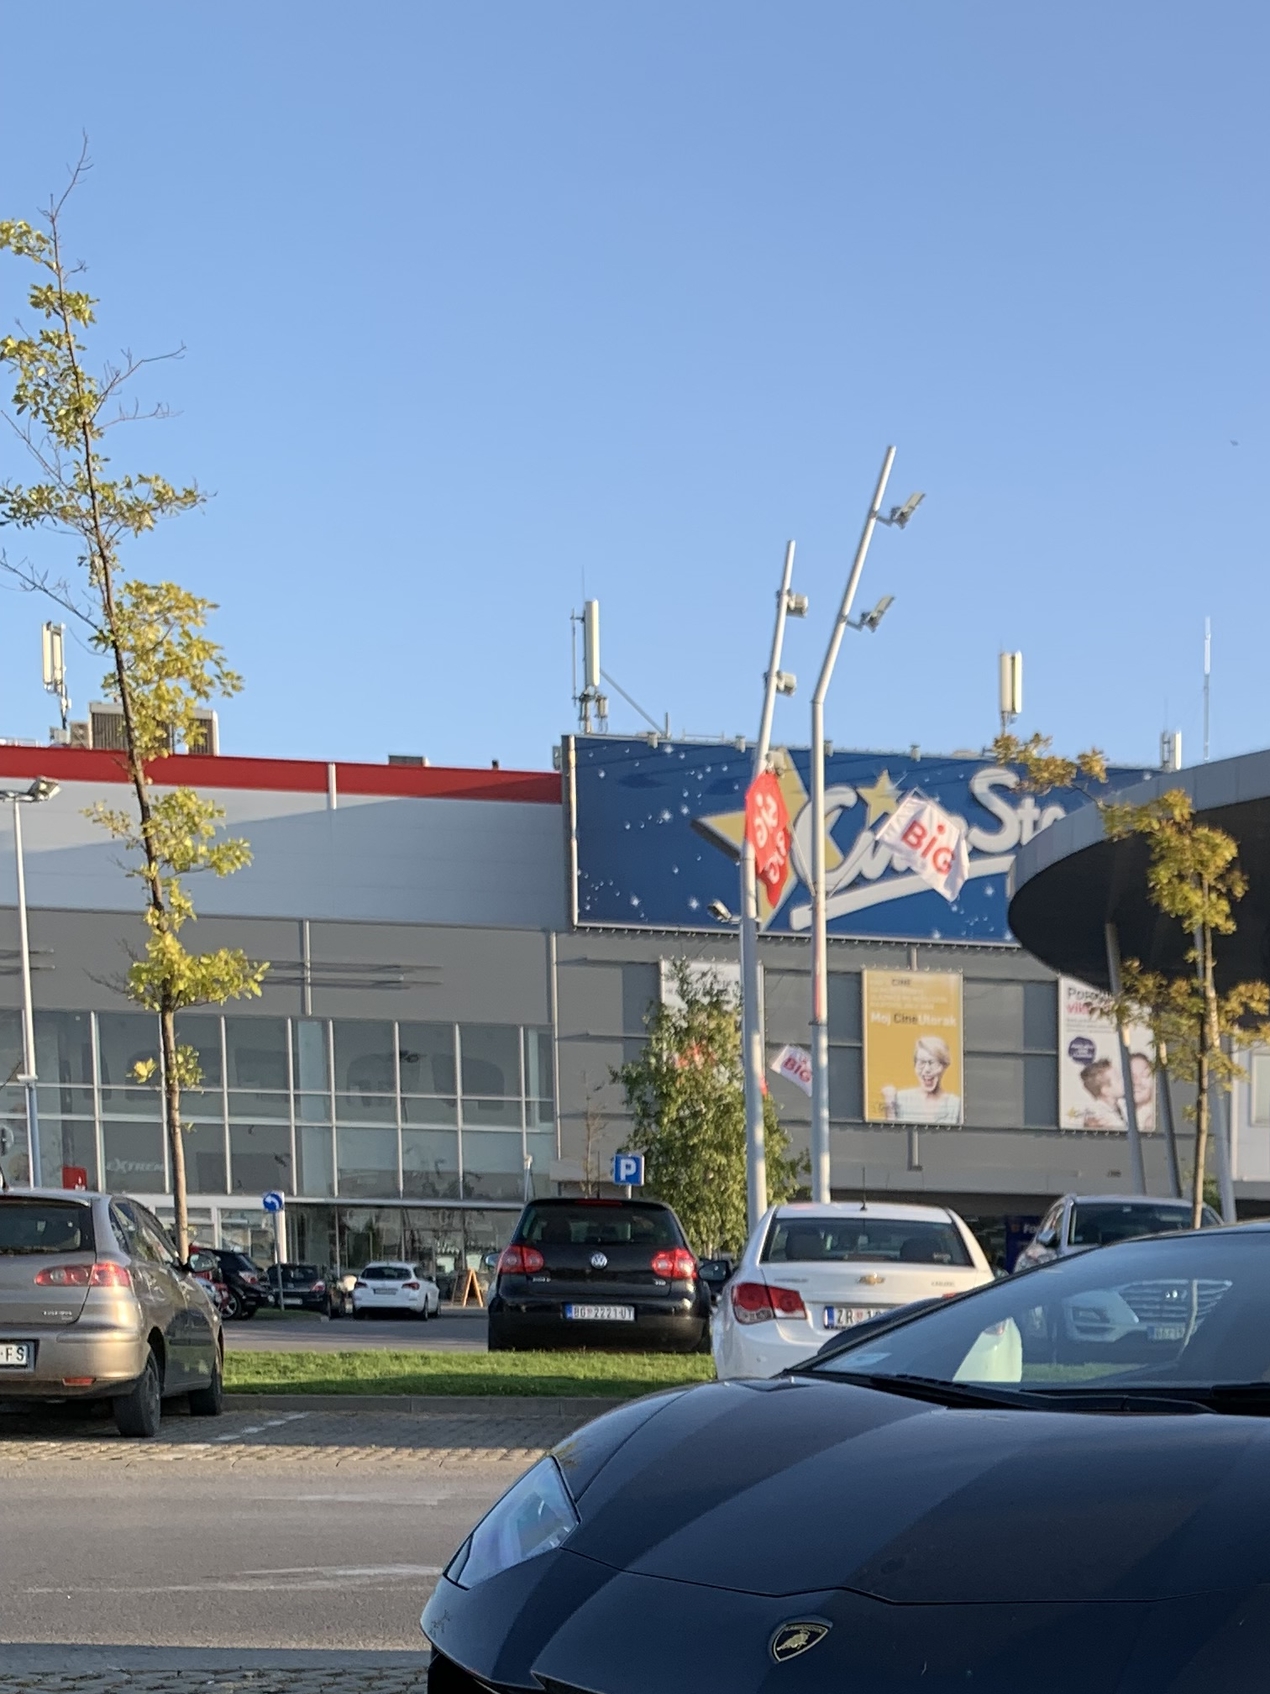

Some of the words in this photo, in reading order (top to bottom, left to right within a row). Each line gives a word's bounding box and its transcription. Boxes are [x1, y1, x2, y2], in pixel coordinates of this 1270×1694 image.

[620, 1158, 637, 1181] P
[573, 1306, 586, 1318] BG
[837, 1309, 855, 1324] ZR
